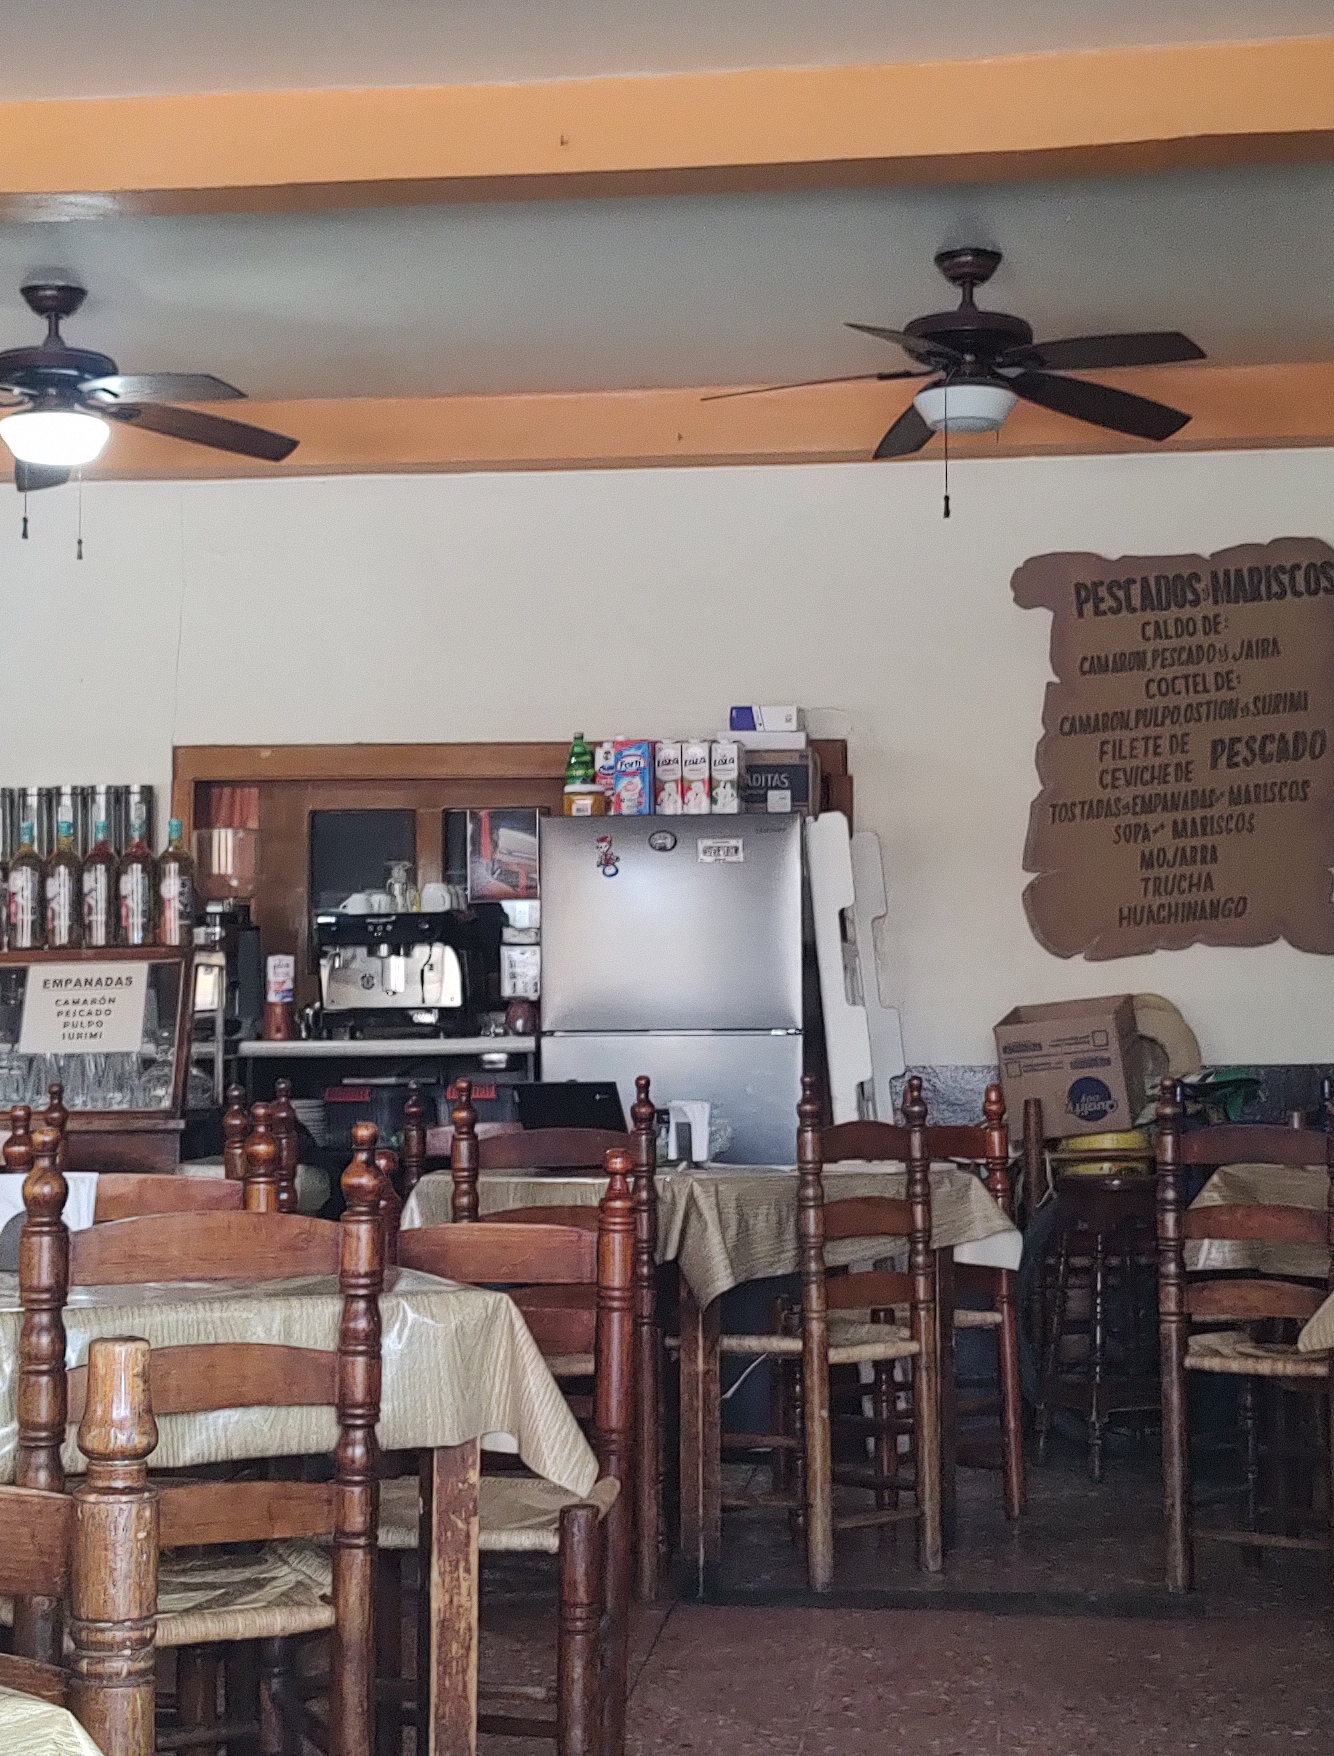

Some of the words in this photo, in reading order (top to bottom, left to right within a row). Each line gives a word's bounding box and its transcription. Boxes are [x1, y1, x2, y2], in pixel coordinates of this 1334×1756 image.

[1074, 572, 1202, 618] PESCADOS
[1141, 615, 1197, 642] CALDO
[1145, 673, 1210, 699] COCTEL
[1251, 690, 1308, 716] SURIMI
[1099, 735, 1163, 763] FILETE
[1169, 732, 1191, 755] DE
[1209, 729, 1328, 770] PESCADO
[1099, 762, 1172, 790] CEVICHE
[1174, 760, 1195, 782] DE
[1049, 797, 1121, 825] TOSTADAS
[1132, 787, 1215, 817] EMPANADAS
[1227, 779, 1313, 808] MARISCOS
[1113, 821, 1151, 845] SOPA
[1171, 812, 1256, 840] MARISCOS
[1139, 843, 1219, 871] MOJARRA
[1140, 871, 1215, 899] TRUCHA
[1118, 895, 1248, 928] HUACHINANGO
[42, 976, 133, 990] EMPANADAS
[57, 1008, 112, 1018] PESCADO
[63, 1020, 104, 1029] PULPO
[62, 1031, 103, 1041] SURIMI
